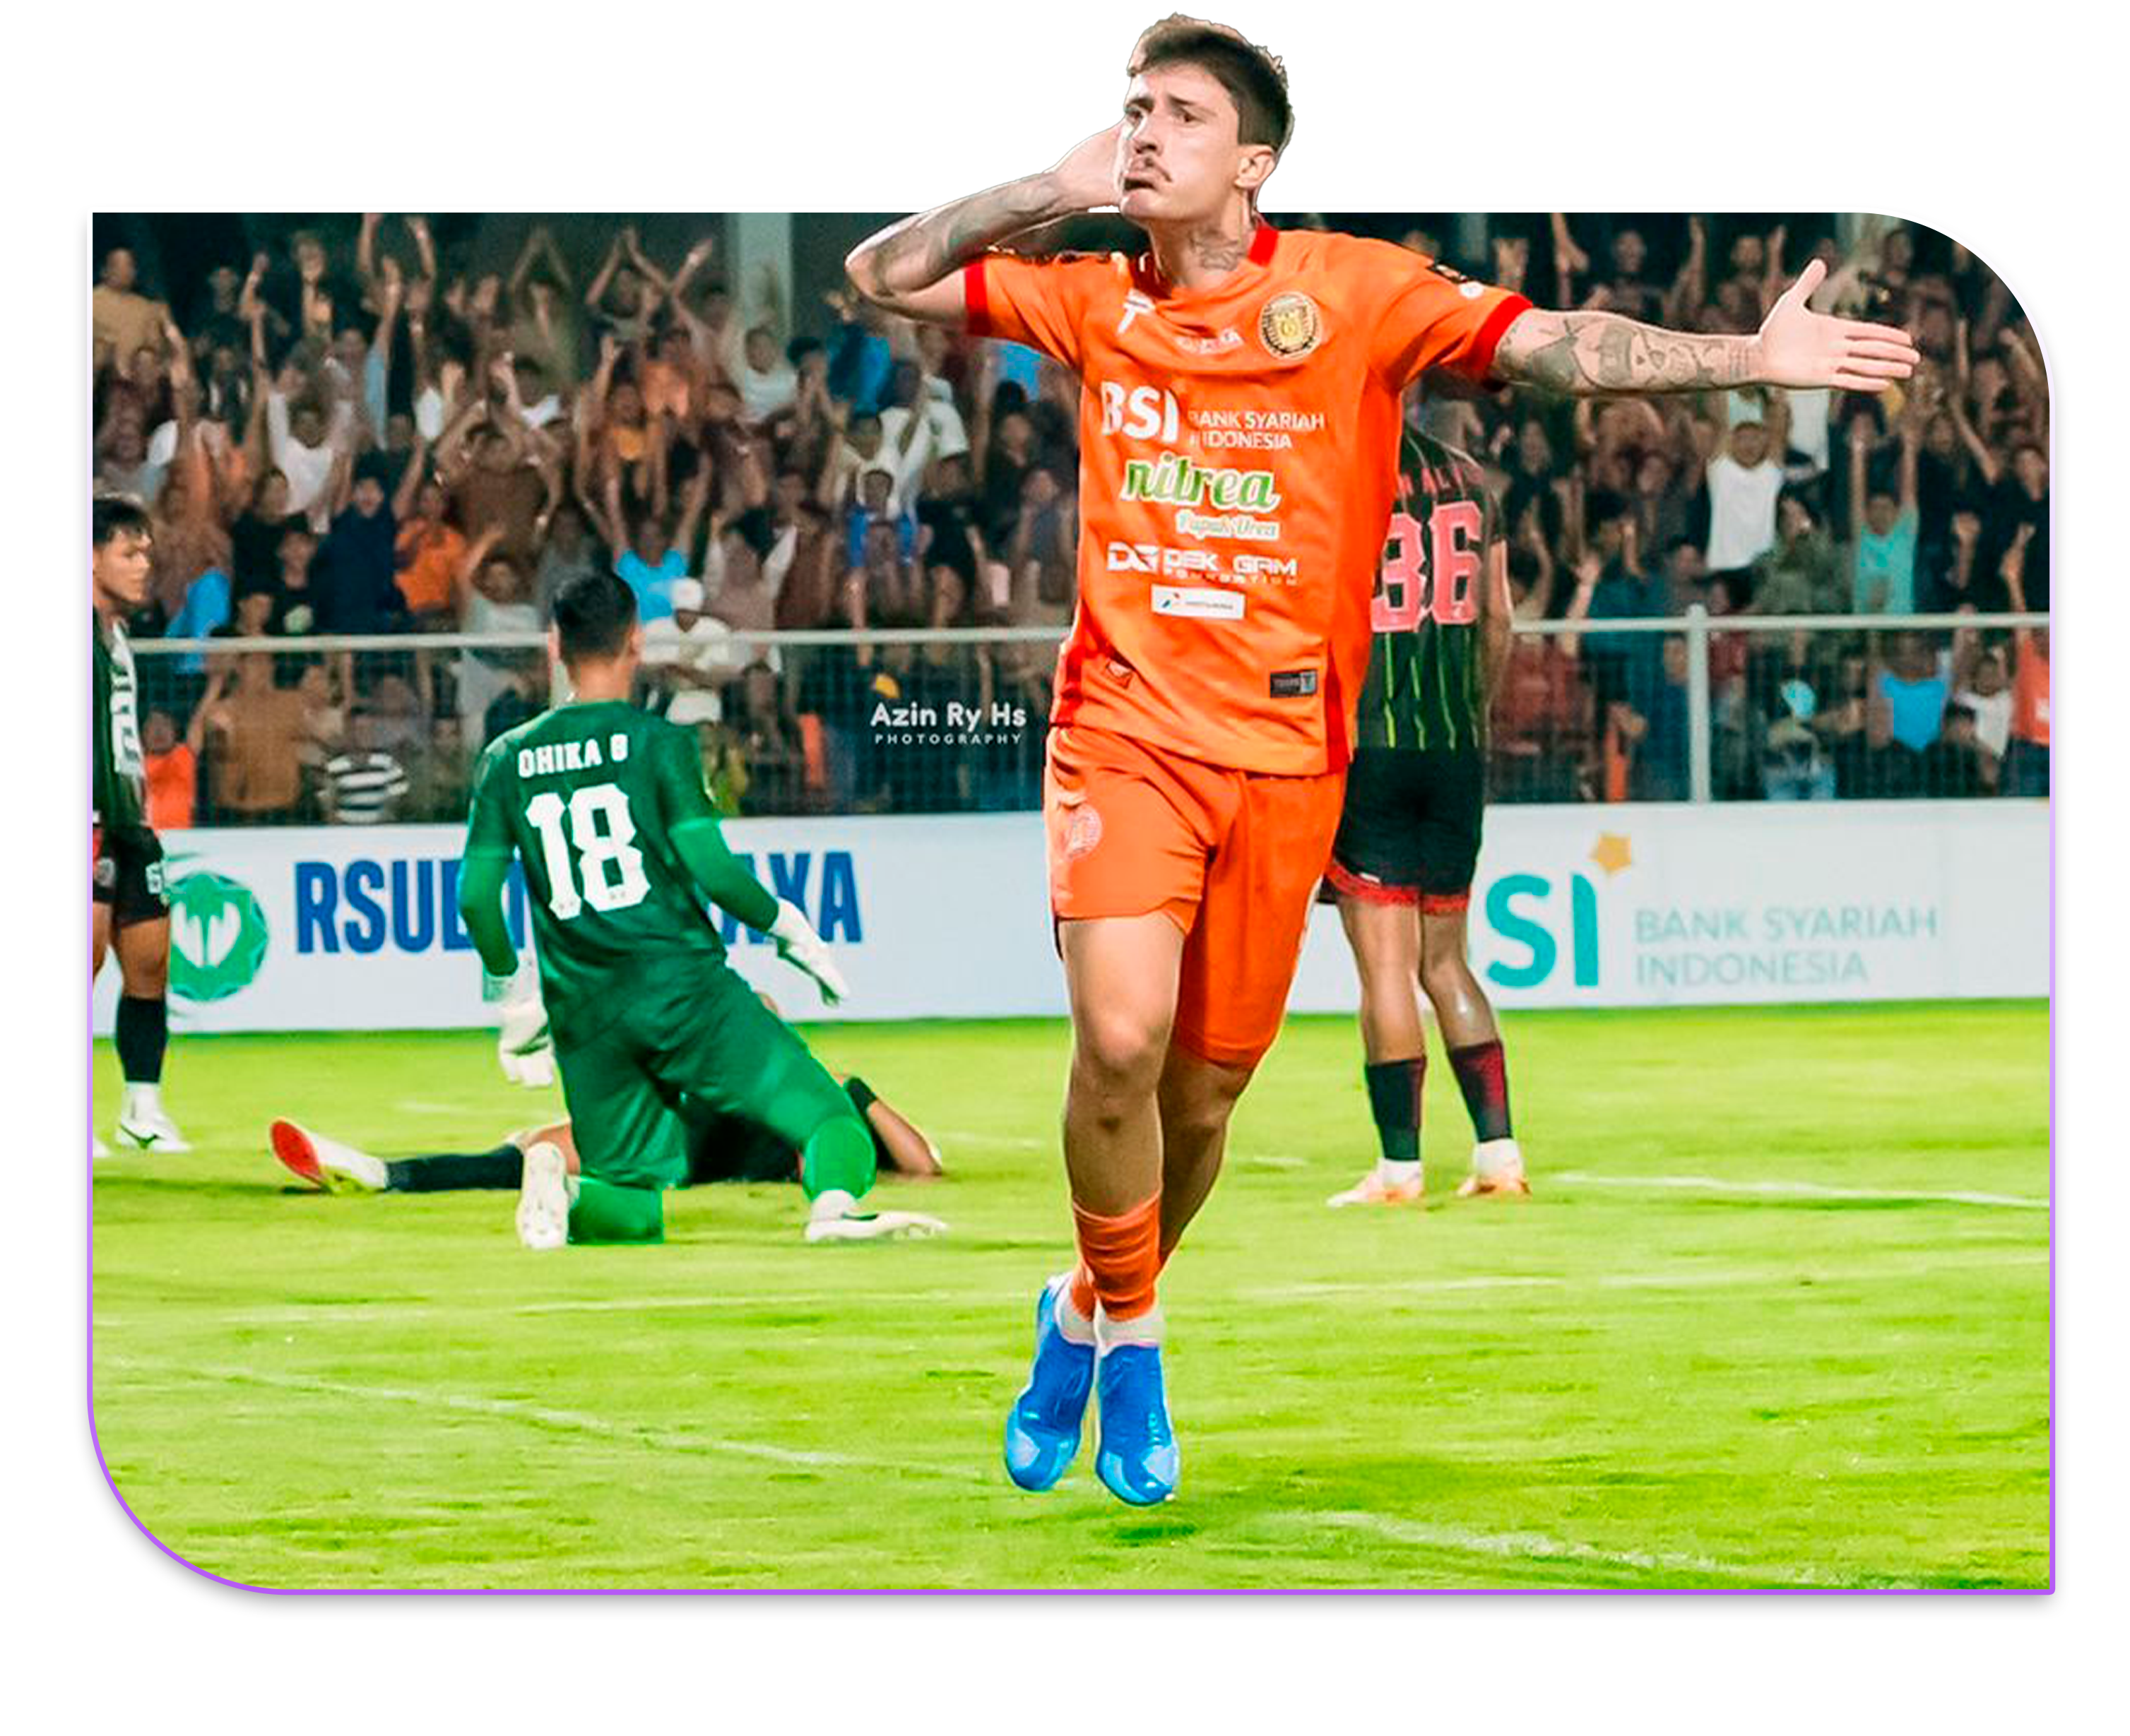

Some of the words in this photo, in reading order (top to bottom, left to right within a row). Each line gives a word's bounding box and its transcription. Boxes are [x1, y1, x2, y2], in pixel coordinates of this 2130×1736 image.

[1100, 380, 1179, 444] BSI
[1244, 410, 1325, 432] SYARIAH
[1120, 451, 1282, 513] nitrea
[1370, 500, 1481, 633] 36
[525, 782, 651, 920] 18
[1485, 873, 1599, 988] SI
[1634, 907, 1749, 944] BANK
[1764, 905, 1938, 941] SYARIAH
[1634, 950, 1869, 987] INDONESIA
